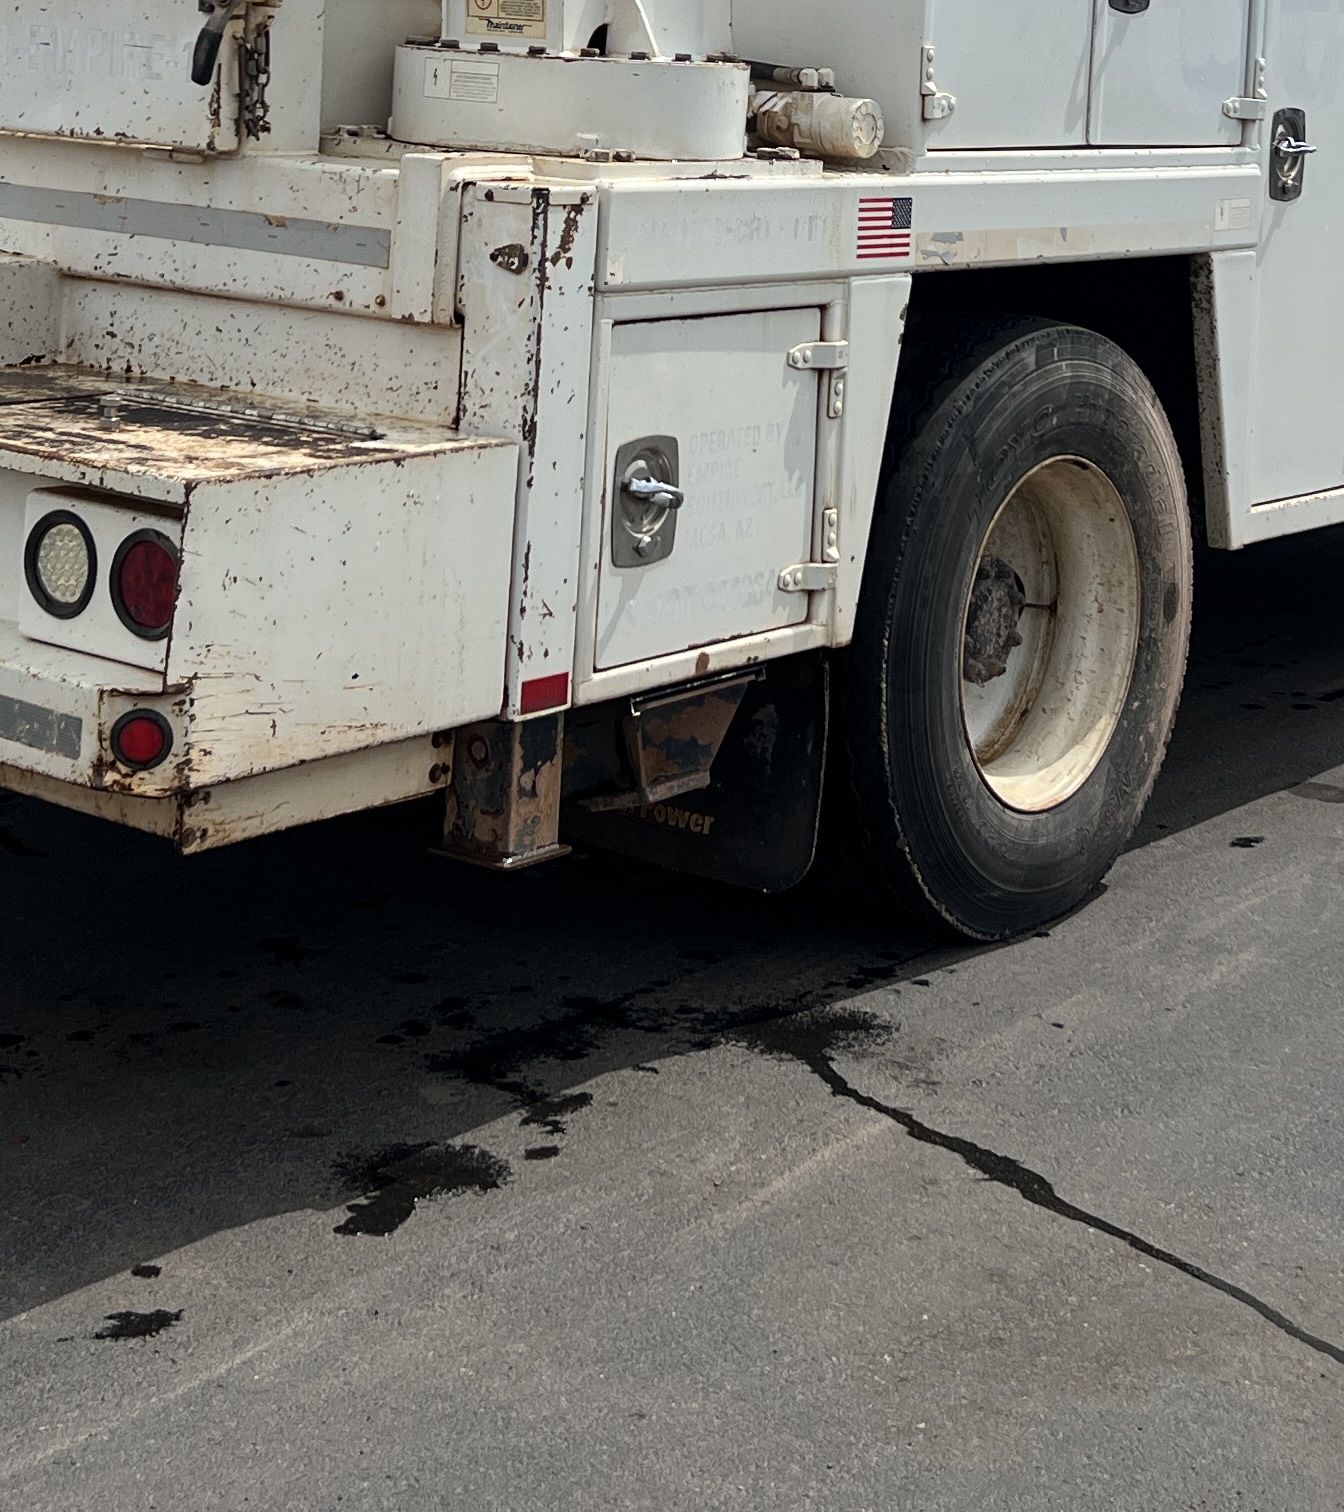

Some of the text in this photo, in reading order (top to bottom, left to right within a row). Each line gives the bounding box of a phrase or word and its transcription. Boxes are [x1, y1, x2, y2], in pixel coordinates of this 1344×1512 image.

[689, 421, 784, 456] OPERATED BY
[687, 457, 743, 486] EMPIRE
